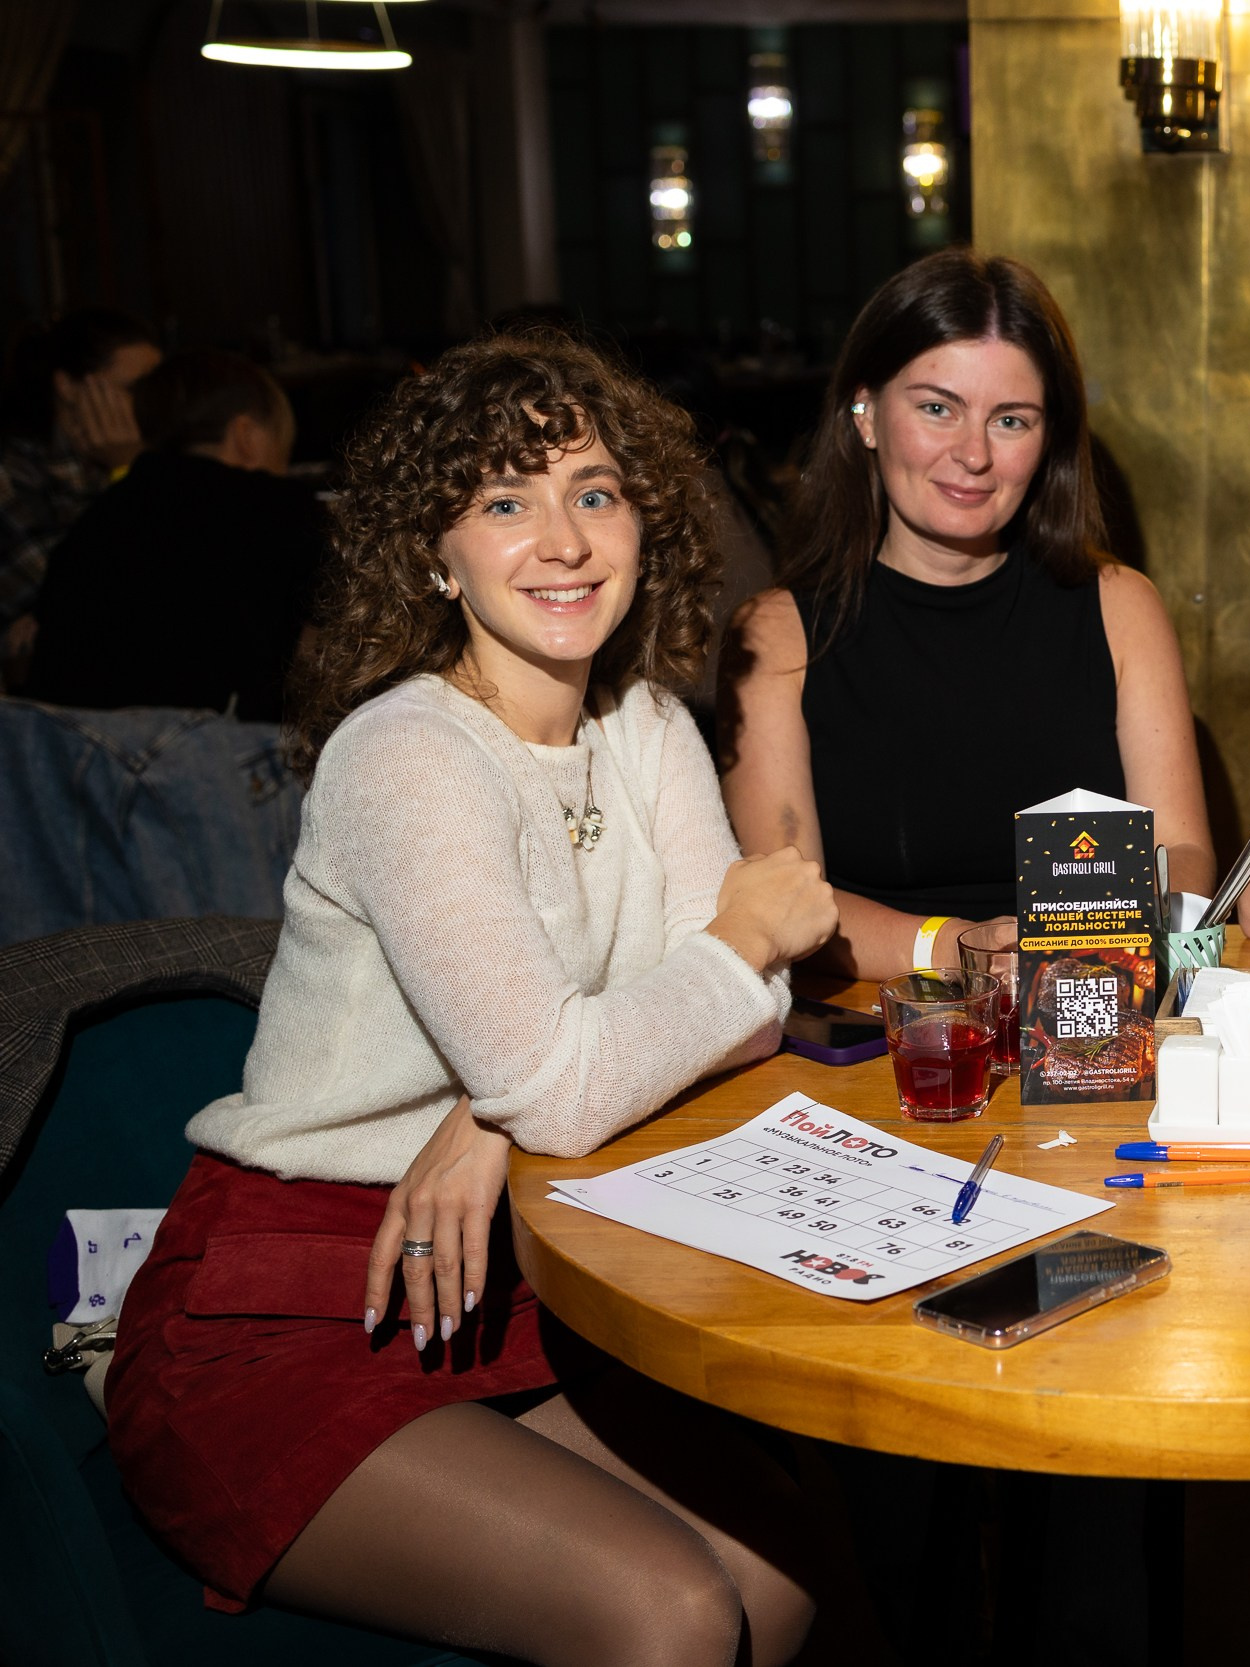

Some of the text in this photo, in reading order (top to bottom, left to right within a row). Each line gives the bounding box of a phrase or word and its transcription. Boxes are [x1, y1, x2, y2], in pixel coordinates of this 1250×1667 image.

[1052, 860, 1117, 877] GASTROLI GRILL
[1032, 898, 1137, 912] ПРИСОЕДИНЯЙСЯ
[1028, 910, 1142, 922] К НАШЕЙ СИСТЕМЕ
[1044, 921, 1126, 932] ЛОЯЛЬНОСТИ
[1022, 936, 1149, 948] СПИСАНИЕ ДО 100% БОНУСОВ
[763, 1126, 873, 1167] «МУЗЫКАЛЬНОЕ ЛОТО»
[755, 1154, 780, 1165] 12
[783, 1164, 811, 1175] 23
[813, 1173, 838, 1185] 34
[912, 1205, 941, 1216] 66
[654, 1170, 906, 1255] 3 25 49 50 76
[696, 1158, 974, 1251] 1 36 41 63 81
[836, 1253, 874, 1268] 87.8 FM
[789, 1267, 832, 1285] РАДИО
